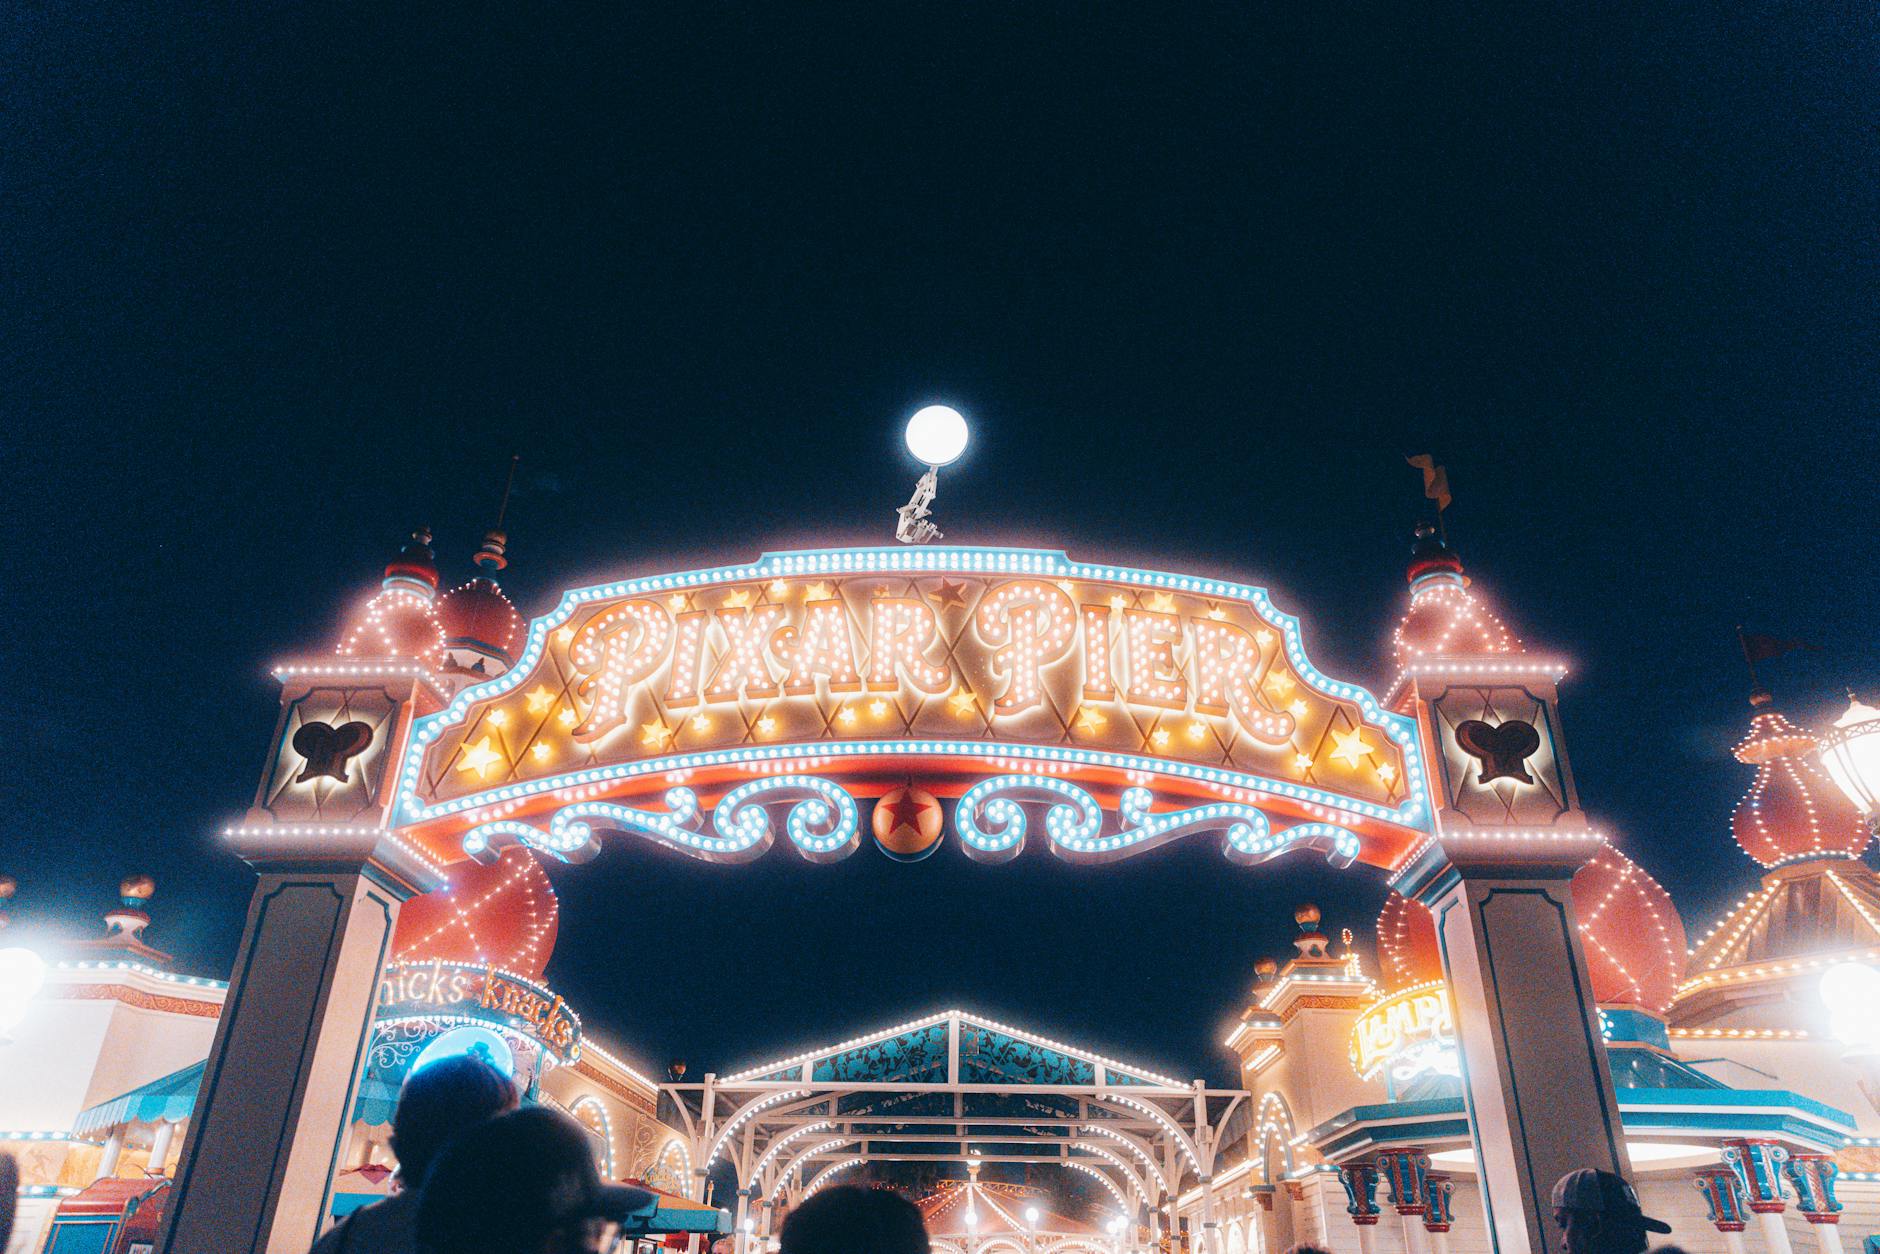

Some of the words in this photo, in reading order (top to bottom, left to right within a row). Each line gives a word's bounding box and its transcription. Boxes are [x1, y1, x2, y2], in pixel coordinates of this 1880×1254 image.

[569, 596, 949, 741] PIXAR
[976, 581, 1297, 746] PIER
[1357, 989, 1456, 1069] LAMPL
